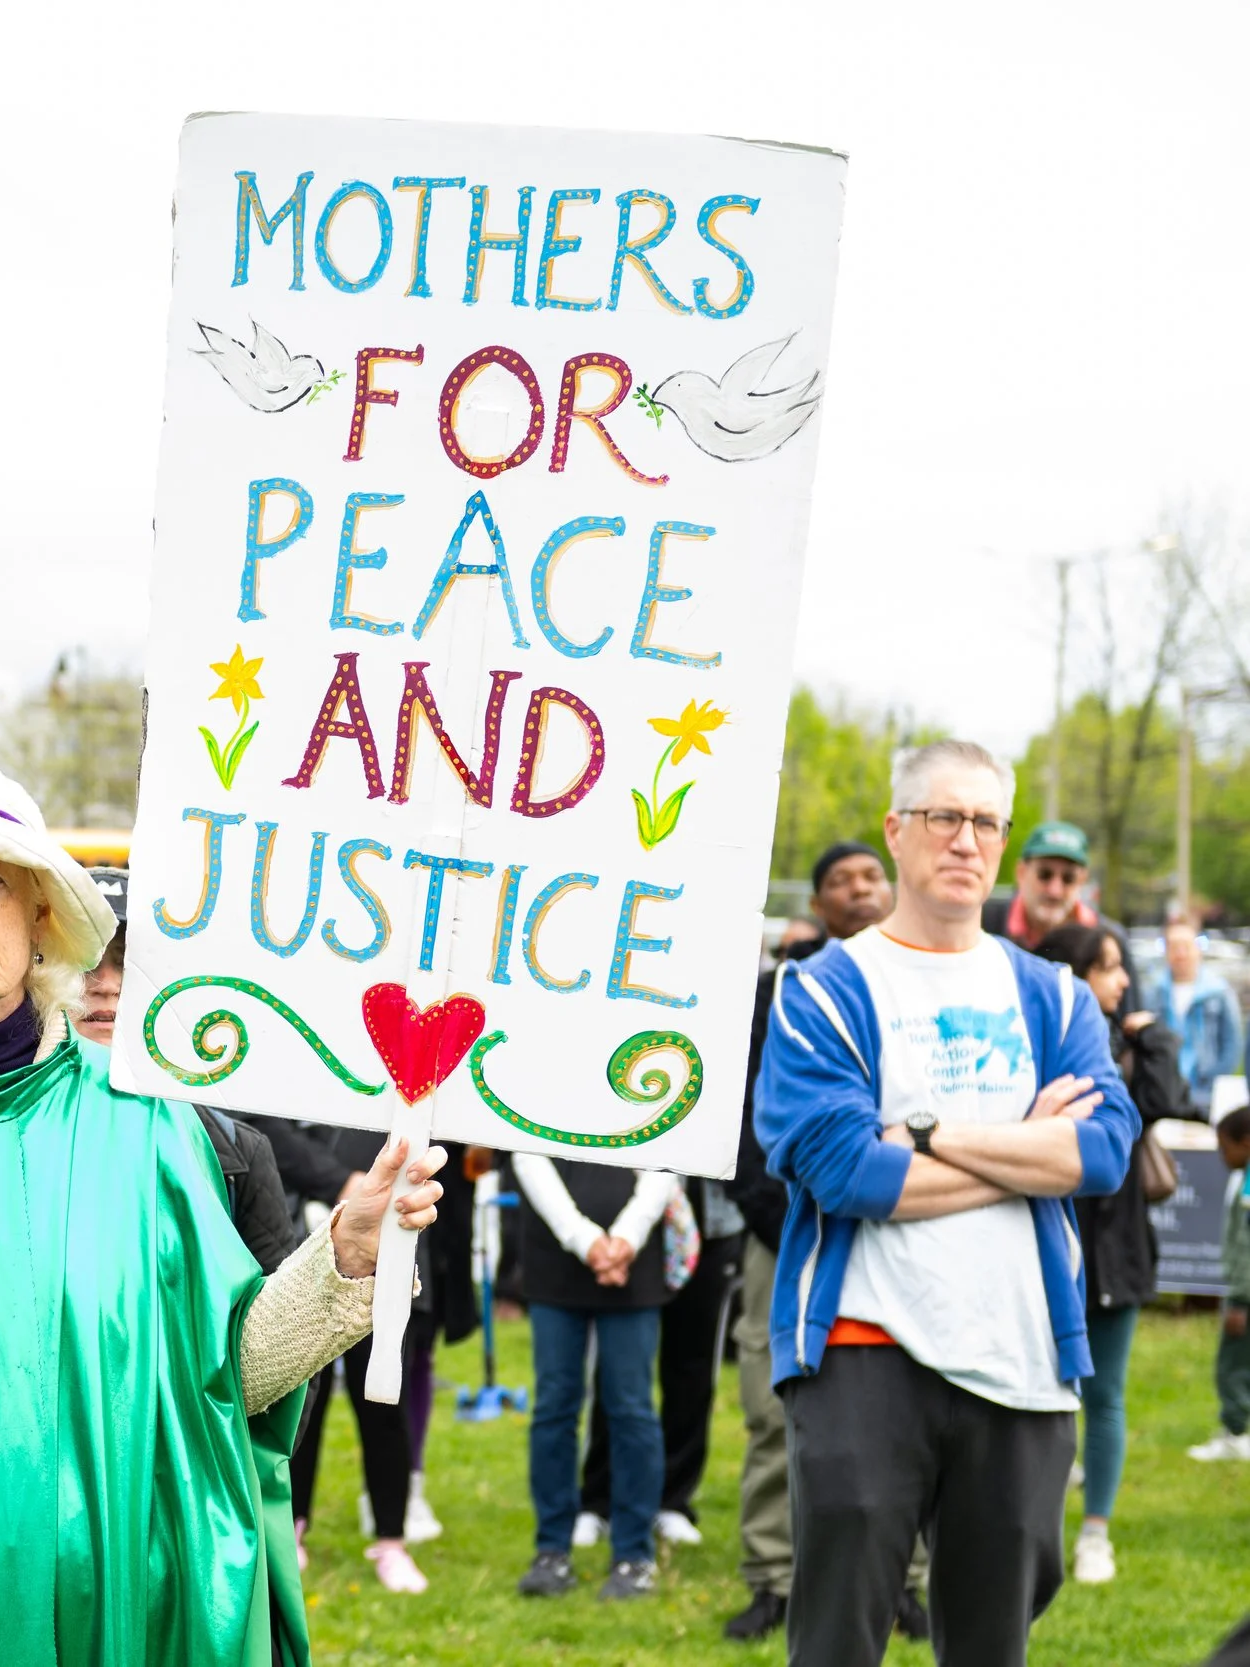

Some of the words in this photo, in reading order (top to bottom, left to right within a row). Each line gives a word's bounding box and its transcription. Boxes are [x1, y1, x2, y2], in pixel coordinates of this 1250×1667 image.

[231, 169, 761, 321] MOTHERS
[342, 344, 671, 489] FOR
[236, 477, 723, 670] PEACE
[280, 651, 607, 819] AND
[151, 806, 699, 1010] JUSTICE
[924, 1061, 970, 1079] Center
